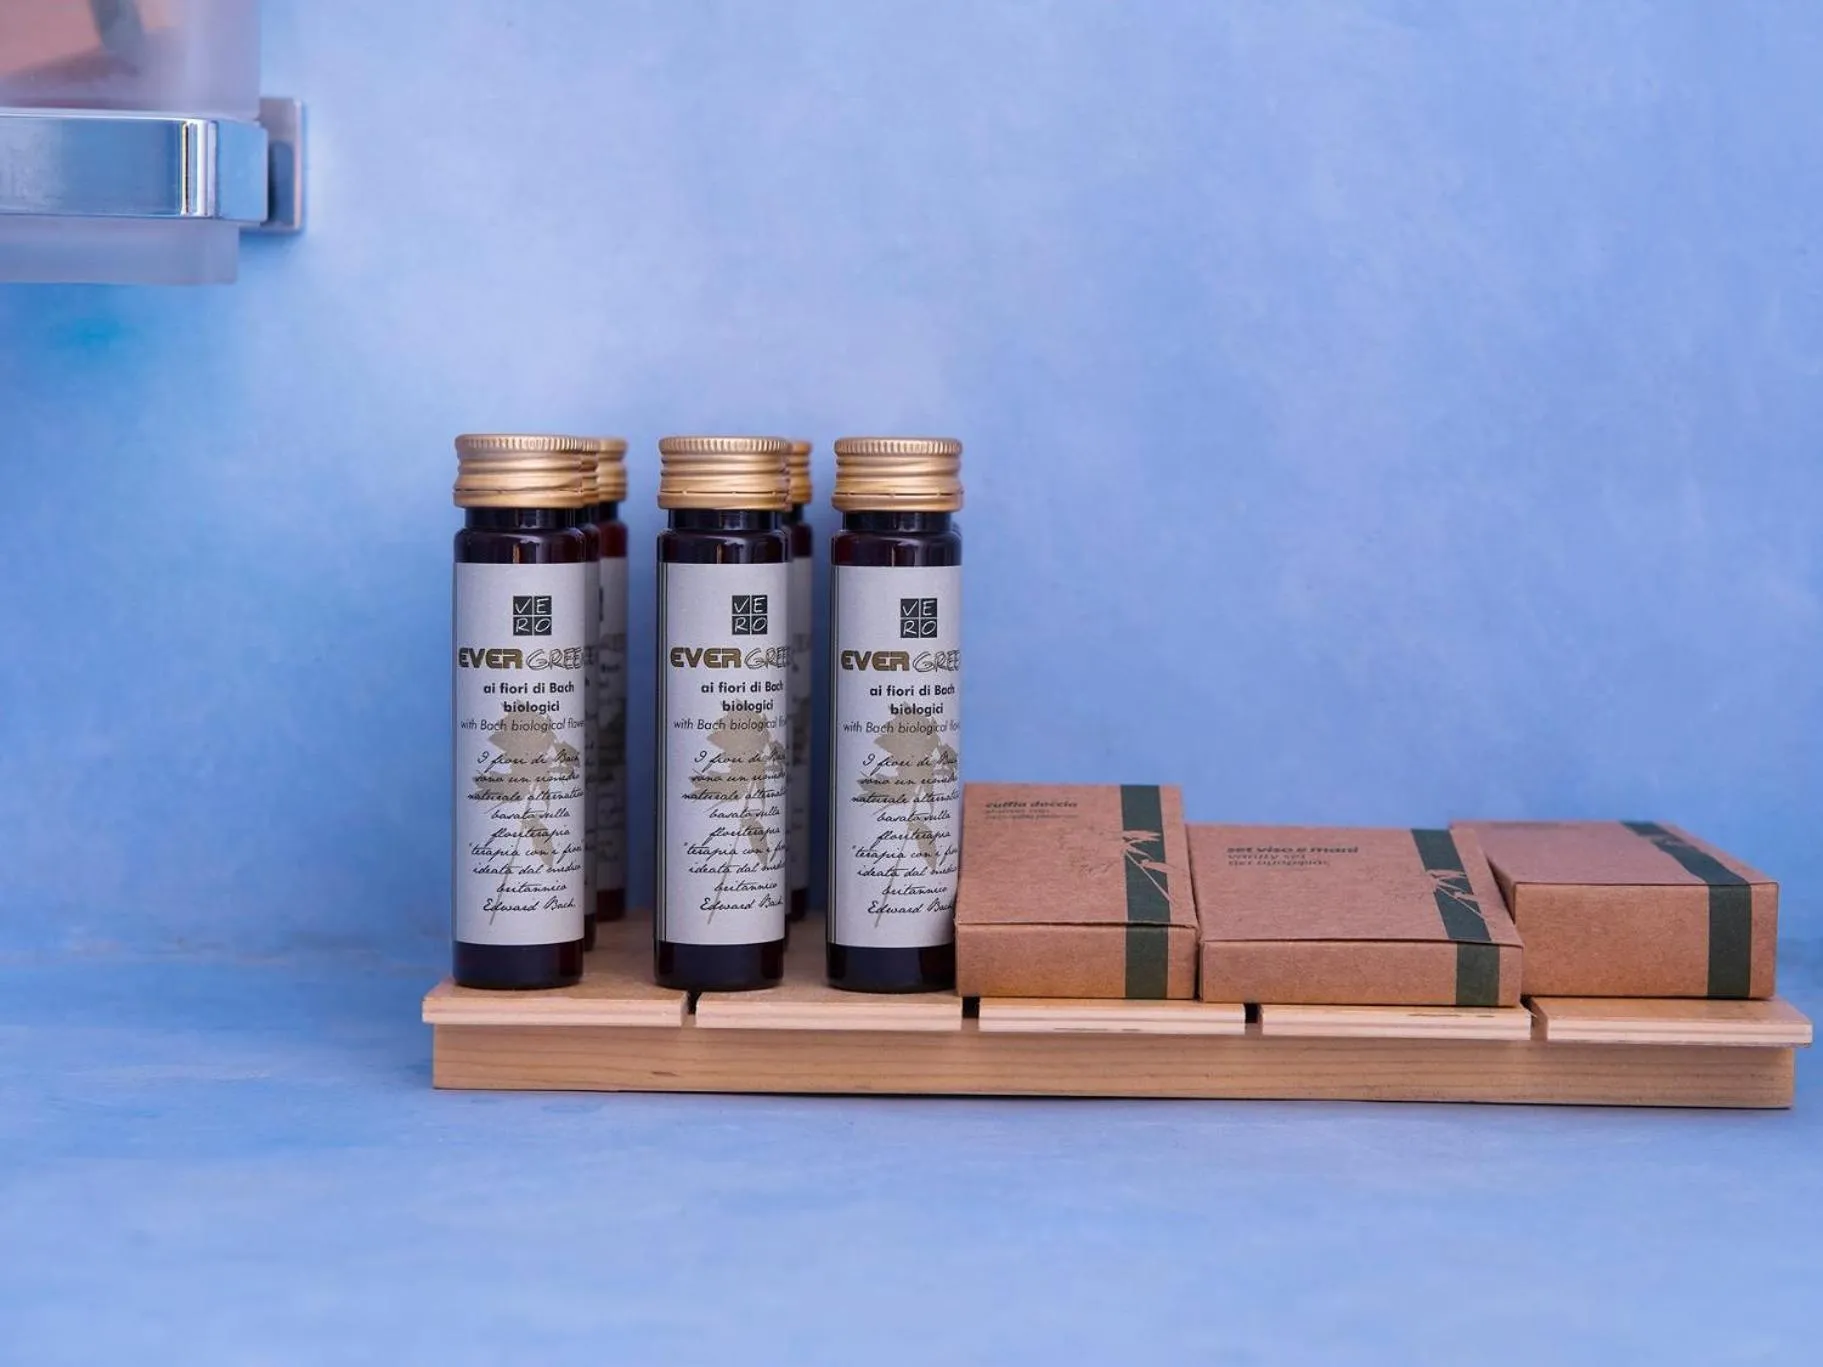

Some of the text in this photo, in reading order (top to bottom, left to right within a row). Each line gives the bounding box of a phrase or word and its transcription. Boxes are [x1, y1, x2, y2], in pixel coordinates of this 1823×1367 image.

[483, 681, 575, 694] ai fiori di Bach
[701, 682, 714, 694] ai
[718, 681, 746, 694] fiori
[750, 681, 762, 693] di
[869, 684, 955, 696] ai fiori di Bach
[503, 700, 560, 714] biologici
[722, 699, 774, 714] biologici
[890, 702, 944, 717] biologici
[461, 720, 478, 730] with
[480, 720, 508, 731] Bach
[511, 718, 566, 733] biological
[673, 719, 694, 730] with
[697, 719, 726, 731] Bach
[843, 721, 862, 733] with
[866, 721, 894, 733] Bach
[530, 753, 548, 765] di
[749, 752, 762, 764] di
[916, 754, 932, 767] di
[508, 775, 532, 783] un
[726, 774, 748, 782] un
[894, 777, 917, 785] un
[467, 790, 523, 802] naturale
[682, 789, 742, 801] naturale
[851, 792, 910, 804] naturale
[519, 863, 541, 875] dal
[736, 862, 758, 873] dal
[904, 865, 925, 877] dal
[482, 898, 539, 912] Edward
[700, 897, 754, 911] Edward
[867, 900, 924, 914] Edward
